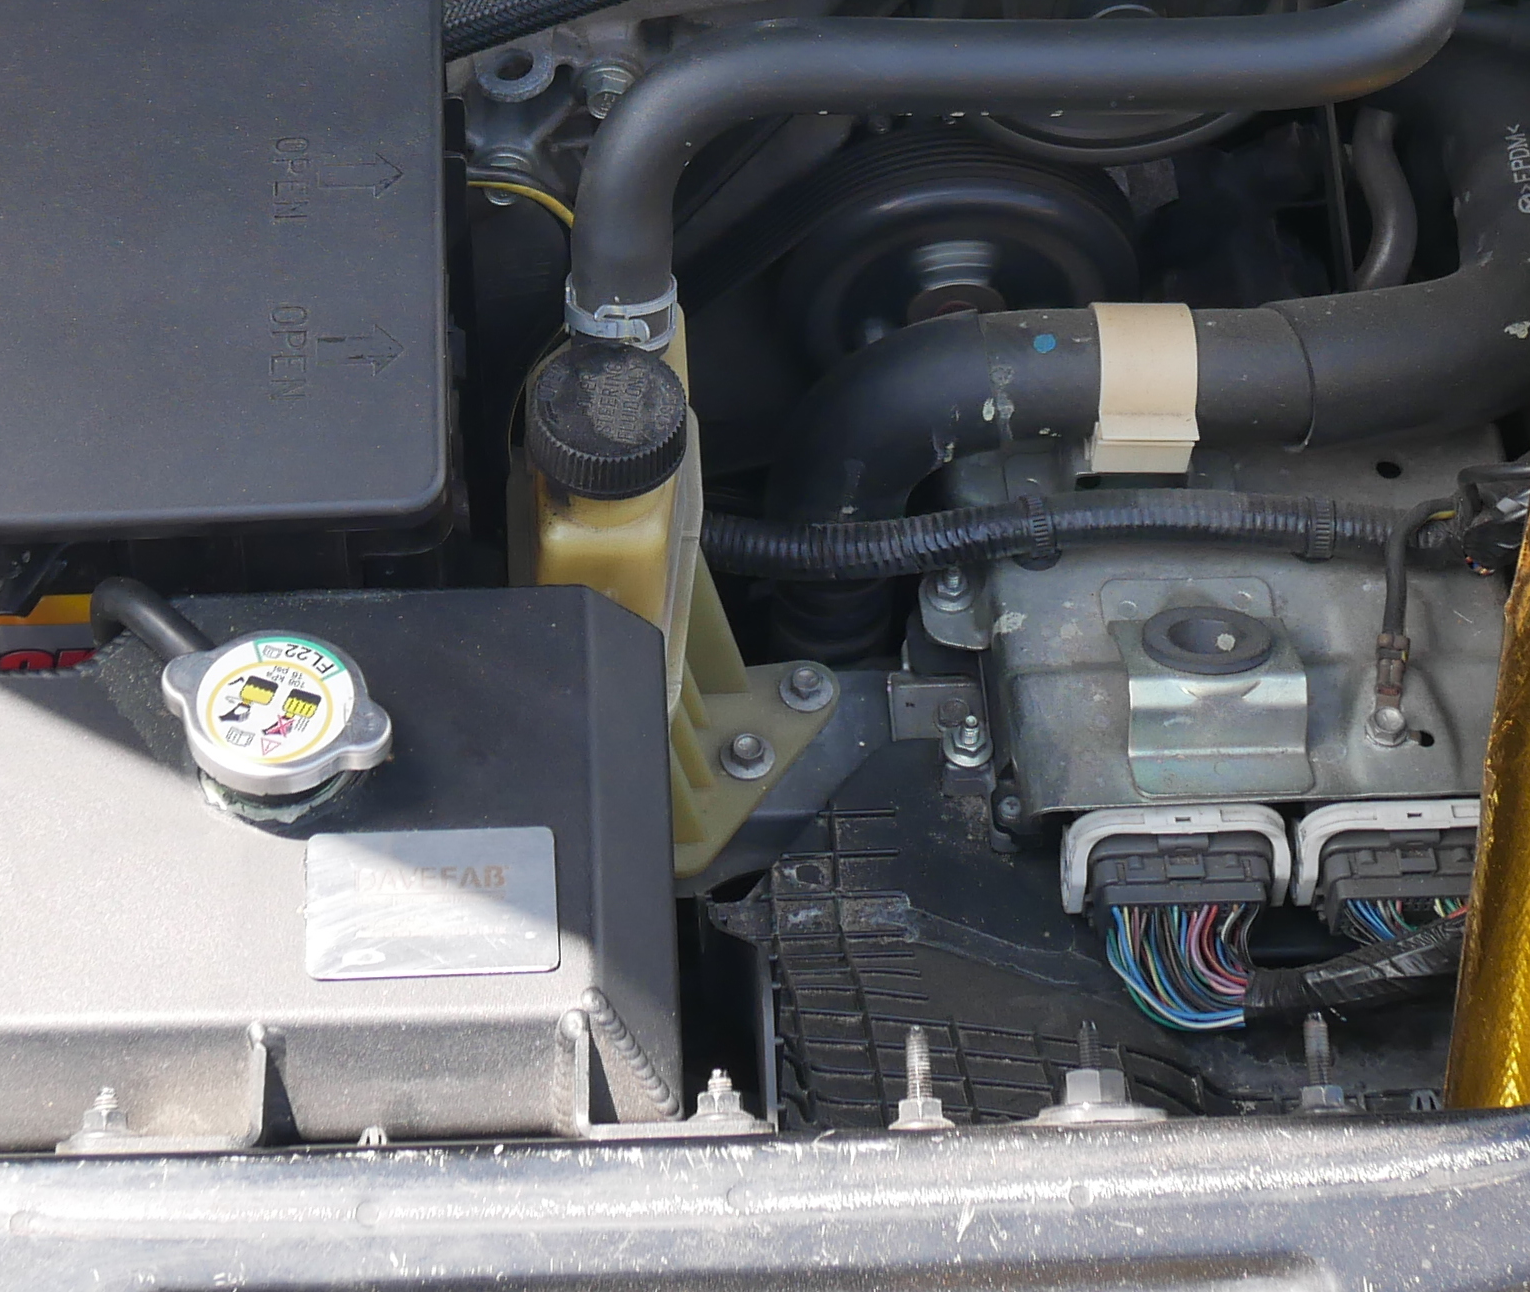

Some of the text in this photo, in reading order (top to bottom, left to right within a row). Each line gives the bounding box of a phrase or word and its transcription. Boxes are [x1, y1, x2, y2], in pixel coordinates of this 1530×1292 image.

[272, 137, 309, 219] OPEN
[269, 306, 308, 400] OPEN
[595, 360, 624, 435] STEERING
[285, 643, 335, 675] FL22
